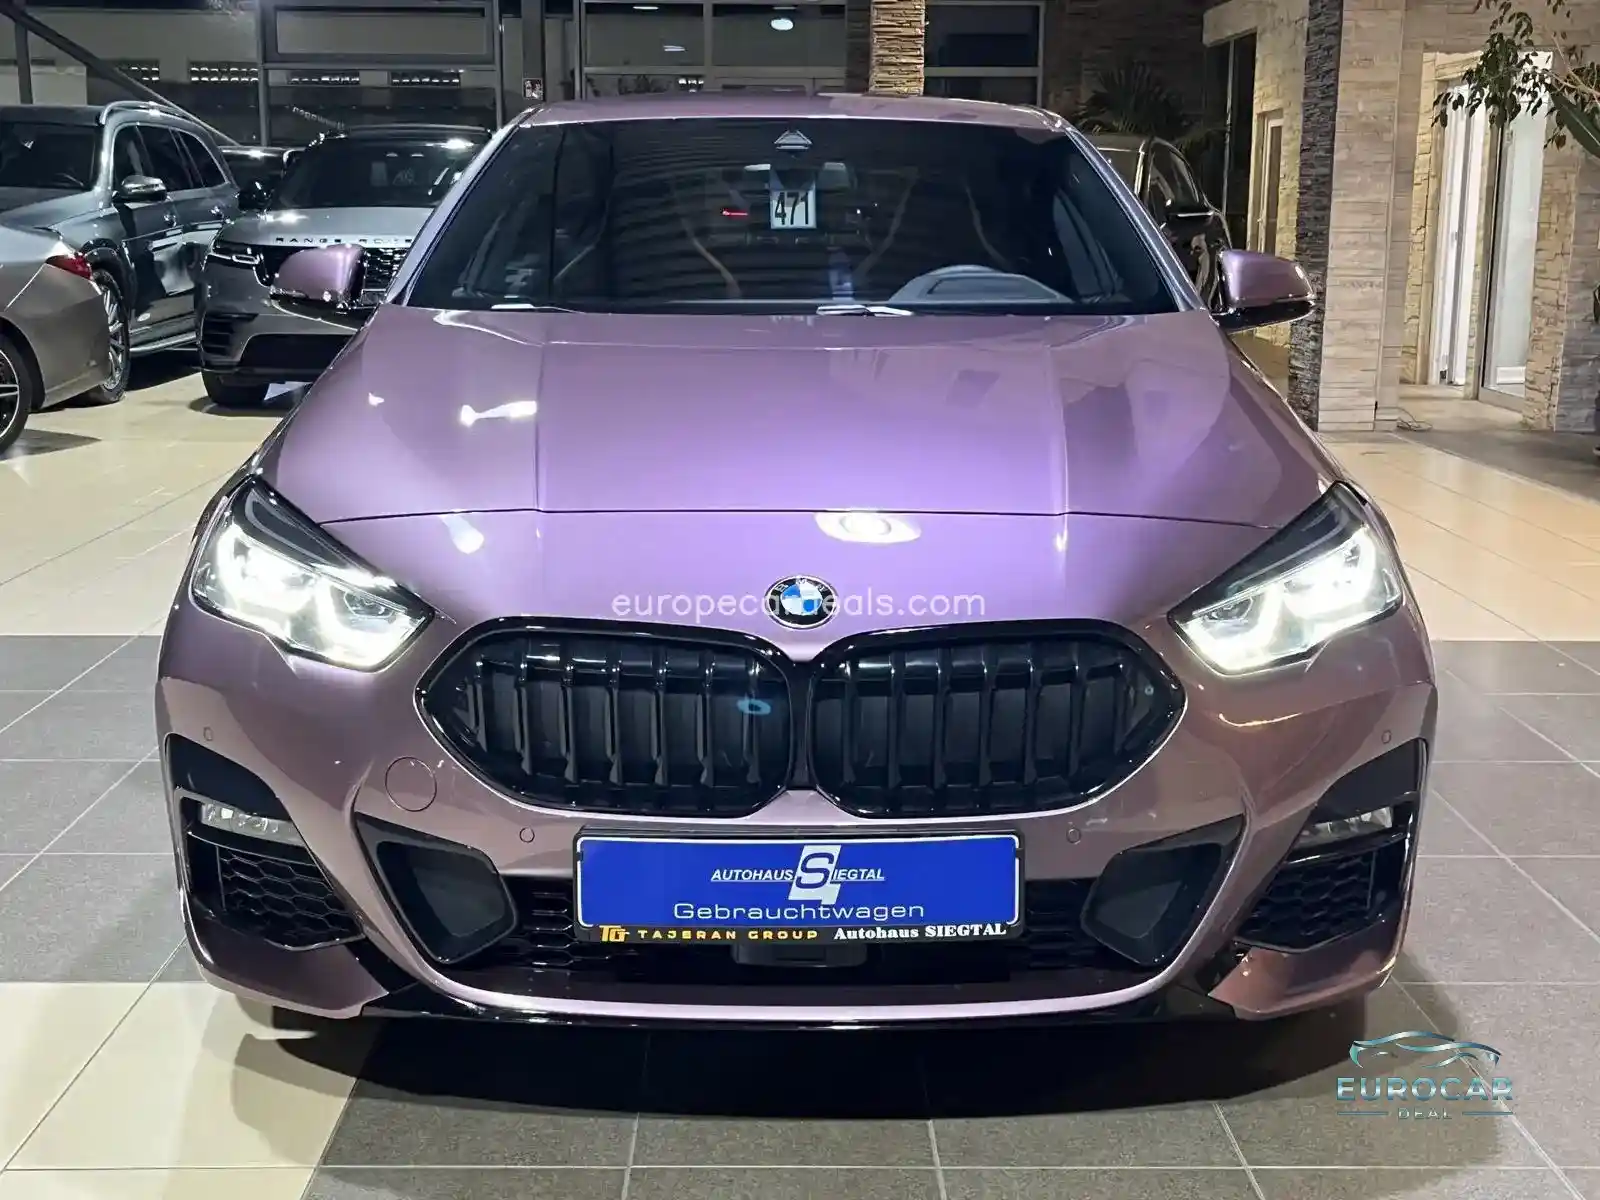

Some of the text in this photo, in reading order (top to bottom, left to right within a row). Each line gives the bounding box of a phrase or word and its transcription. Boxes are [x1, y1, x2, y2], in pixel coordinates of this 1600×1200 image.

[774, 191, 809, 225] 471
[711, 869, 794, 882] AUTOHAUS
[673, 903, 925, 921] Gebrauchtwagen
[637, 929, 737, 940] TAJERAN
[747, 929, 819, 940] GROUP
[833, 927, 919, 940] Autohaus
[924, 923, 1007, 938] SIEGTAL
